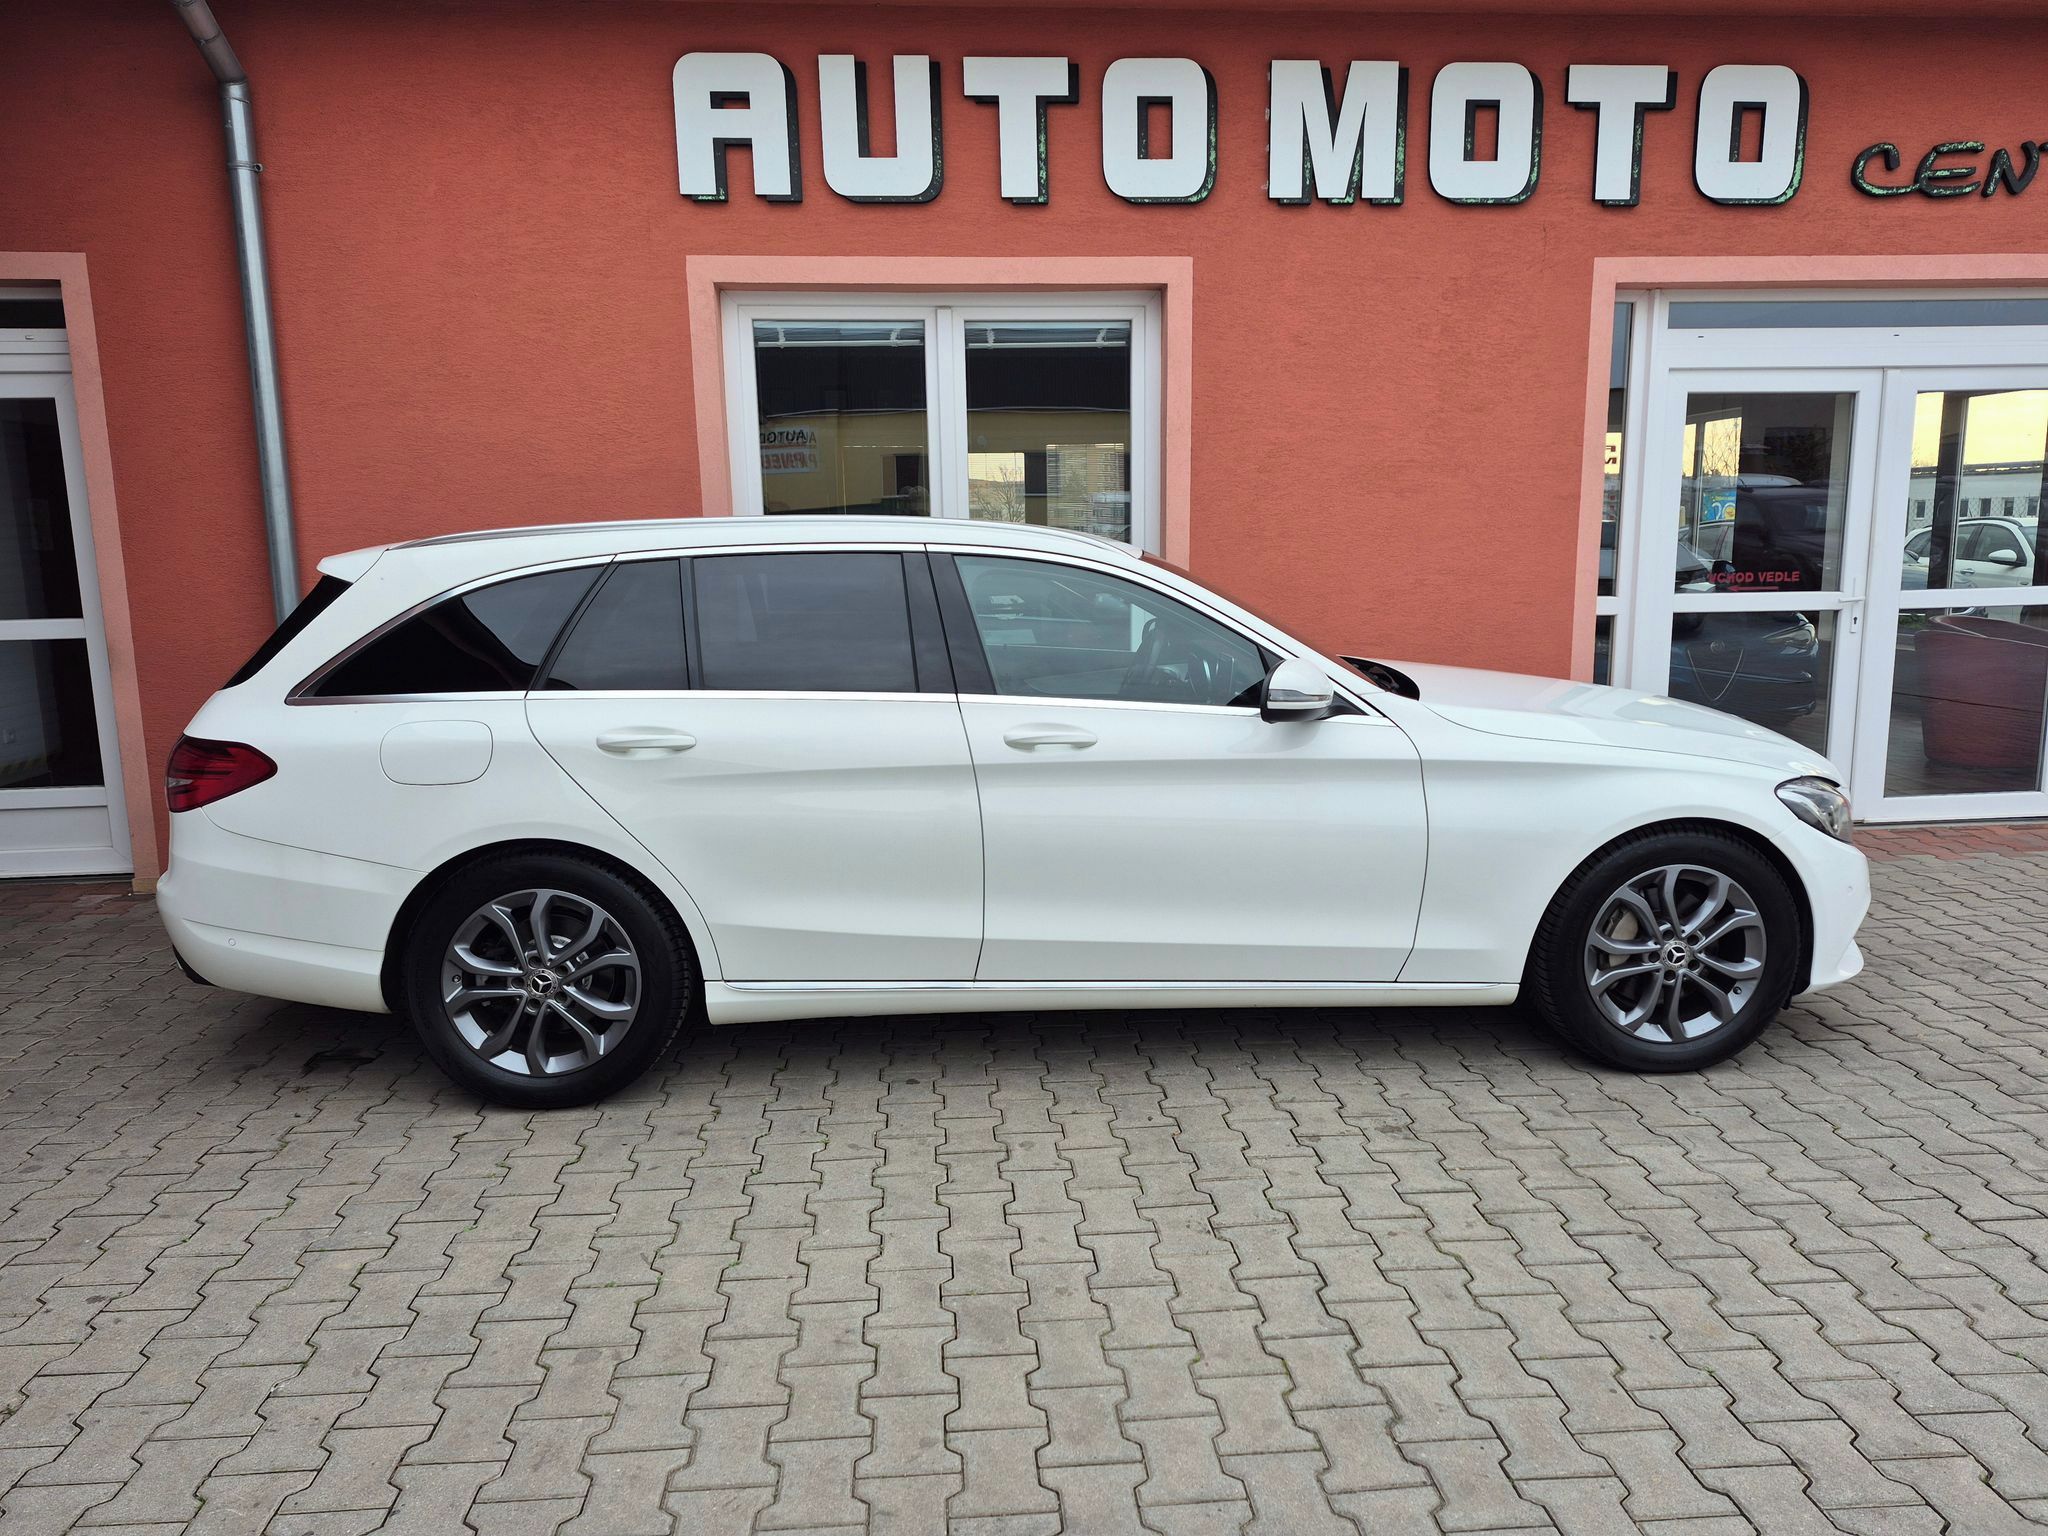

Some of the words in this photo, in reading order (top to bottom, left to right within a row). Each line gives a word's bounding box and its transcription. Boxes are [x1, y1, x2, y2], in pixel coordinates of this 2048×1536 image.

[673, 52, 1218, 203] AUTO
[1268, 60, 1809, 206] MOTO
[1851, 140, 2048, 198] CEN
[1758, 570, 1800, 583] VEDLE
